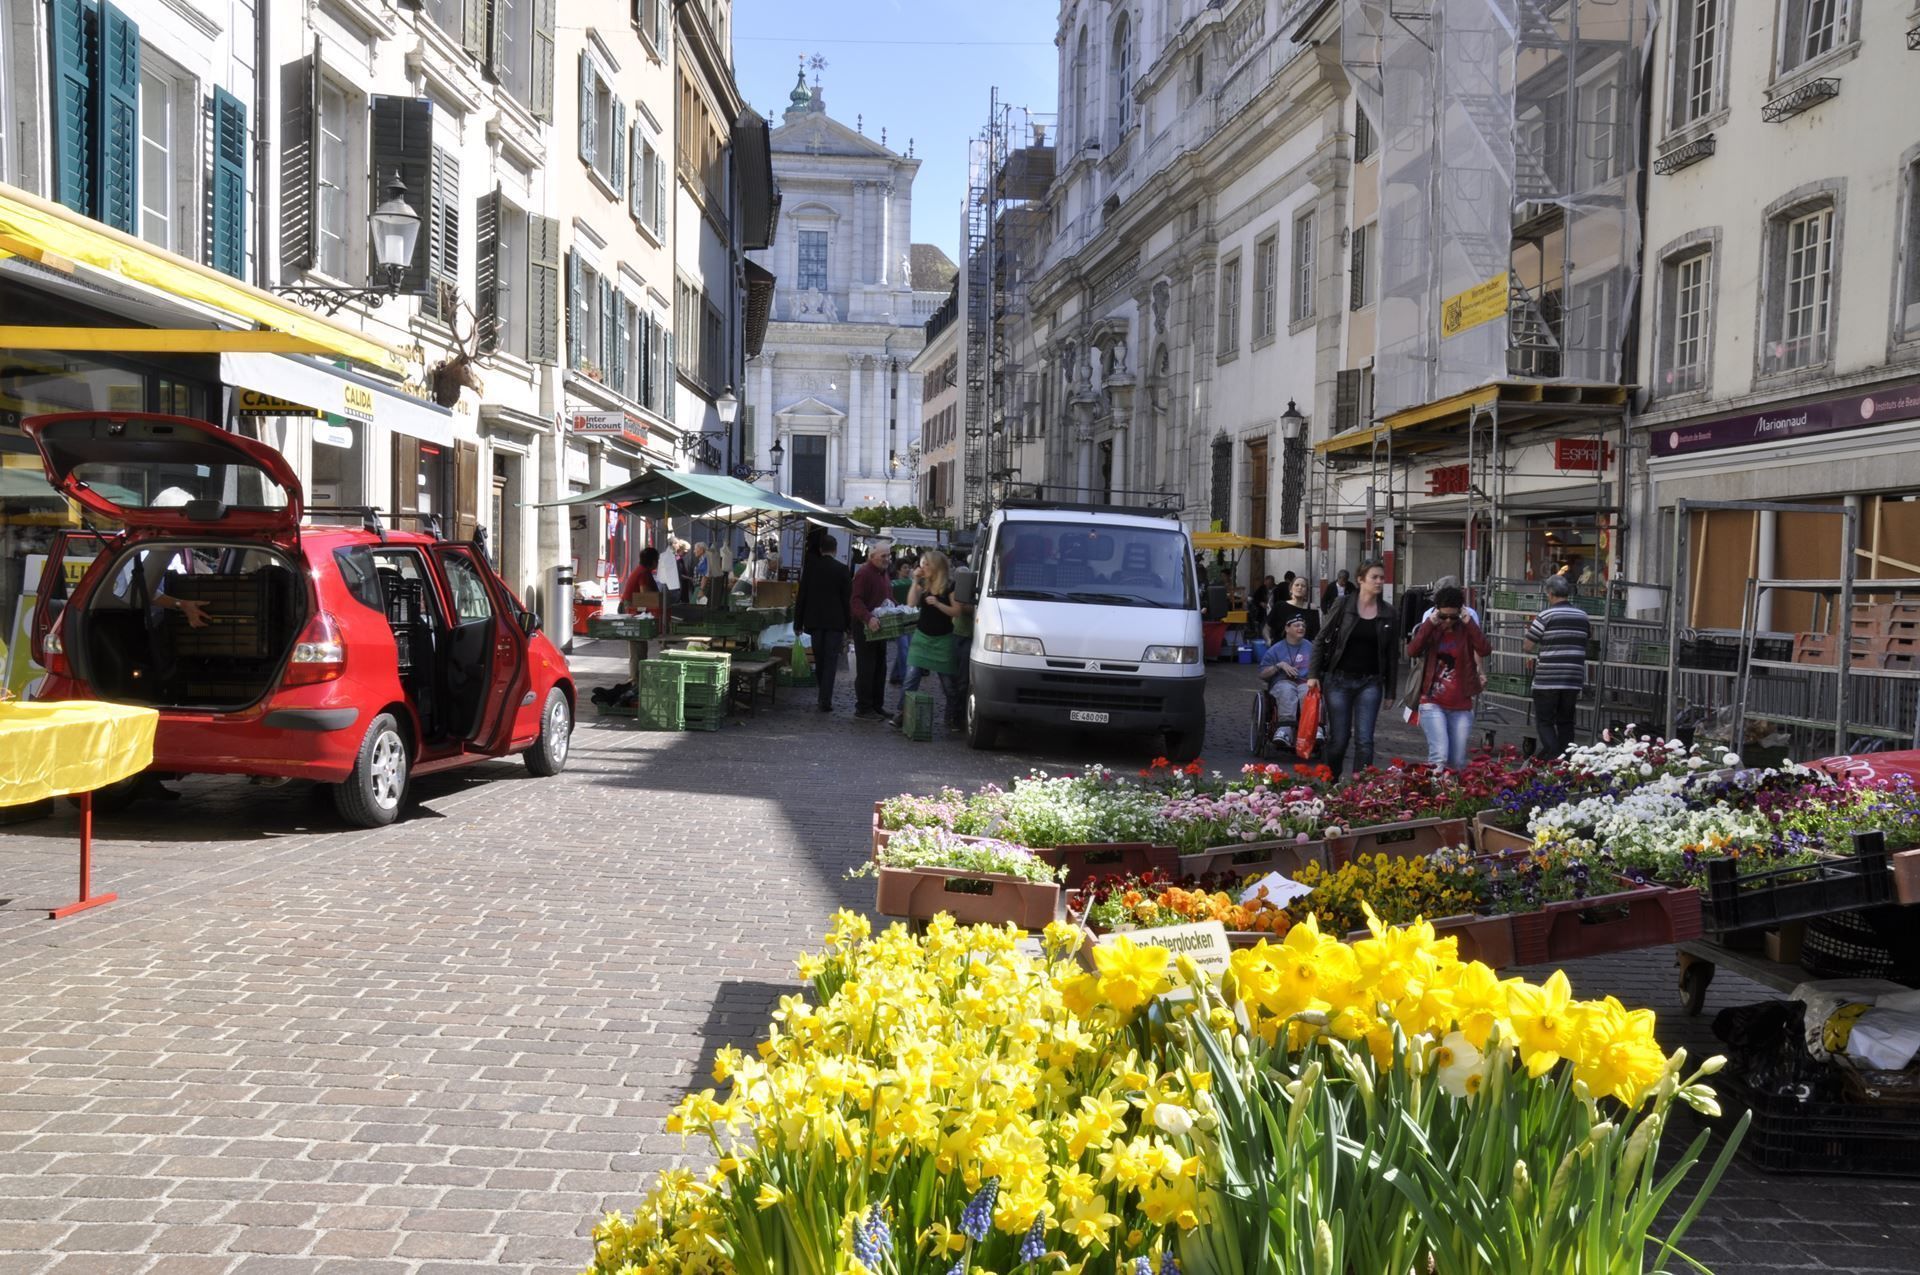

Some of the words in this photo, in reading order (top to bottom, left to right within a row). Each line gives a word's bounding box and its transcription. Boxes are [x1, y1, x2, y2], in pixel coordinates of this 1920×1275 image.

[344, 385, 373, 410] CALIDA
[586, 415, 607, 423] Inter
[1753, 411, 1808, 437] Marionnaud
[1071, 712, 1080, 720] BE
